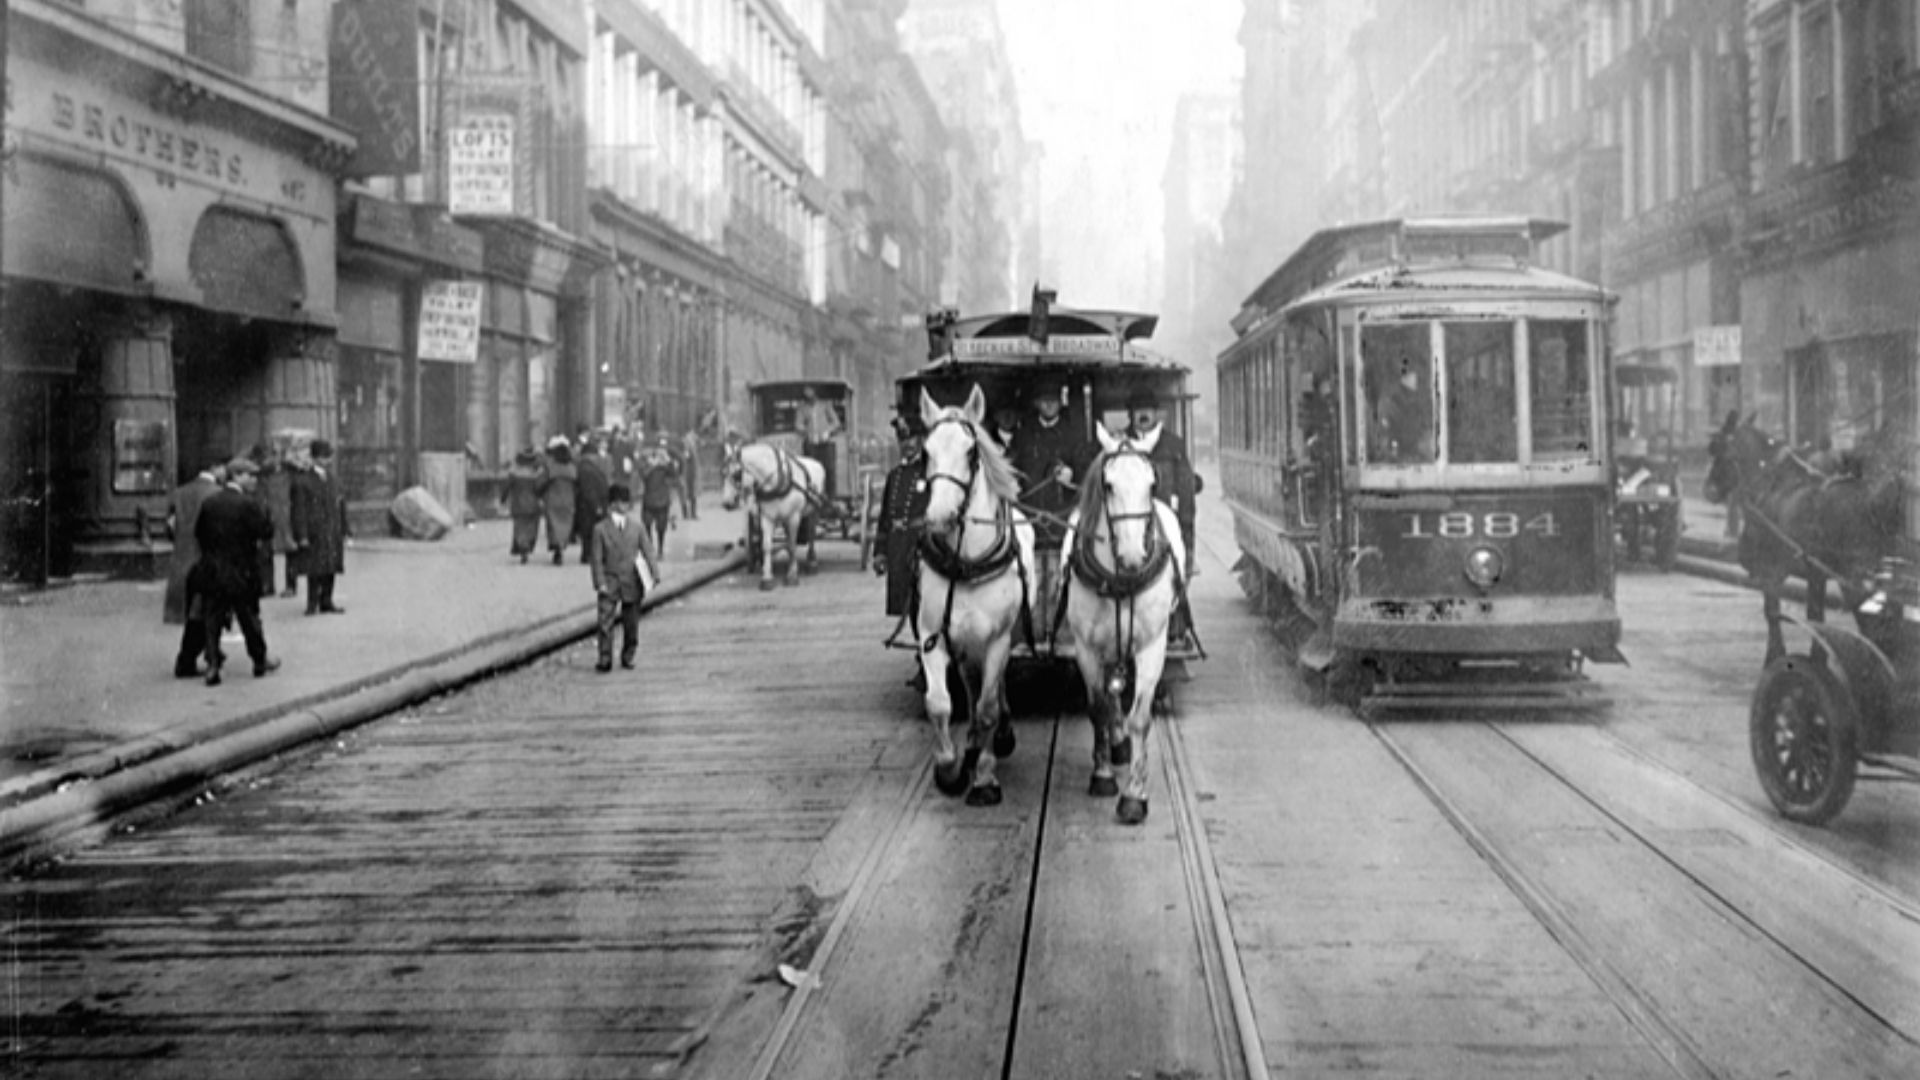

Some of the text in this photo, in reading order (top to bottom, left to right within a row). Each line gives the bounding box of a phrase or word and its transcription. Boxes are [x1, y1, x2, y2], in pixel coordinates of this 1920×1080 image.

[52, 92, 249, 187] BROTHERS.
[453, 132, 510, 147] LOFTS
[457, 150, 476, 159] TO
[1053, 338, 1120, 353] BROADWAY
[1401, 511, 1562, 539] 1884
